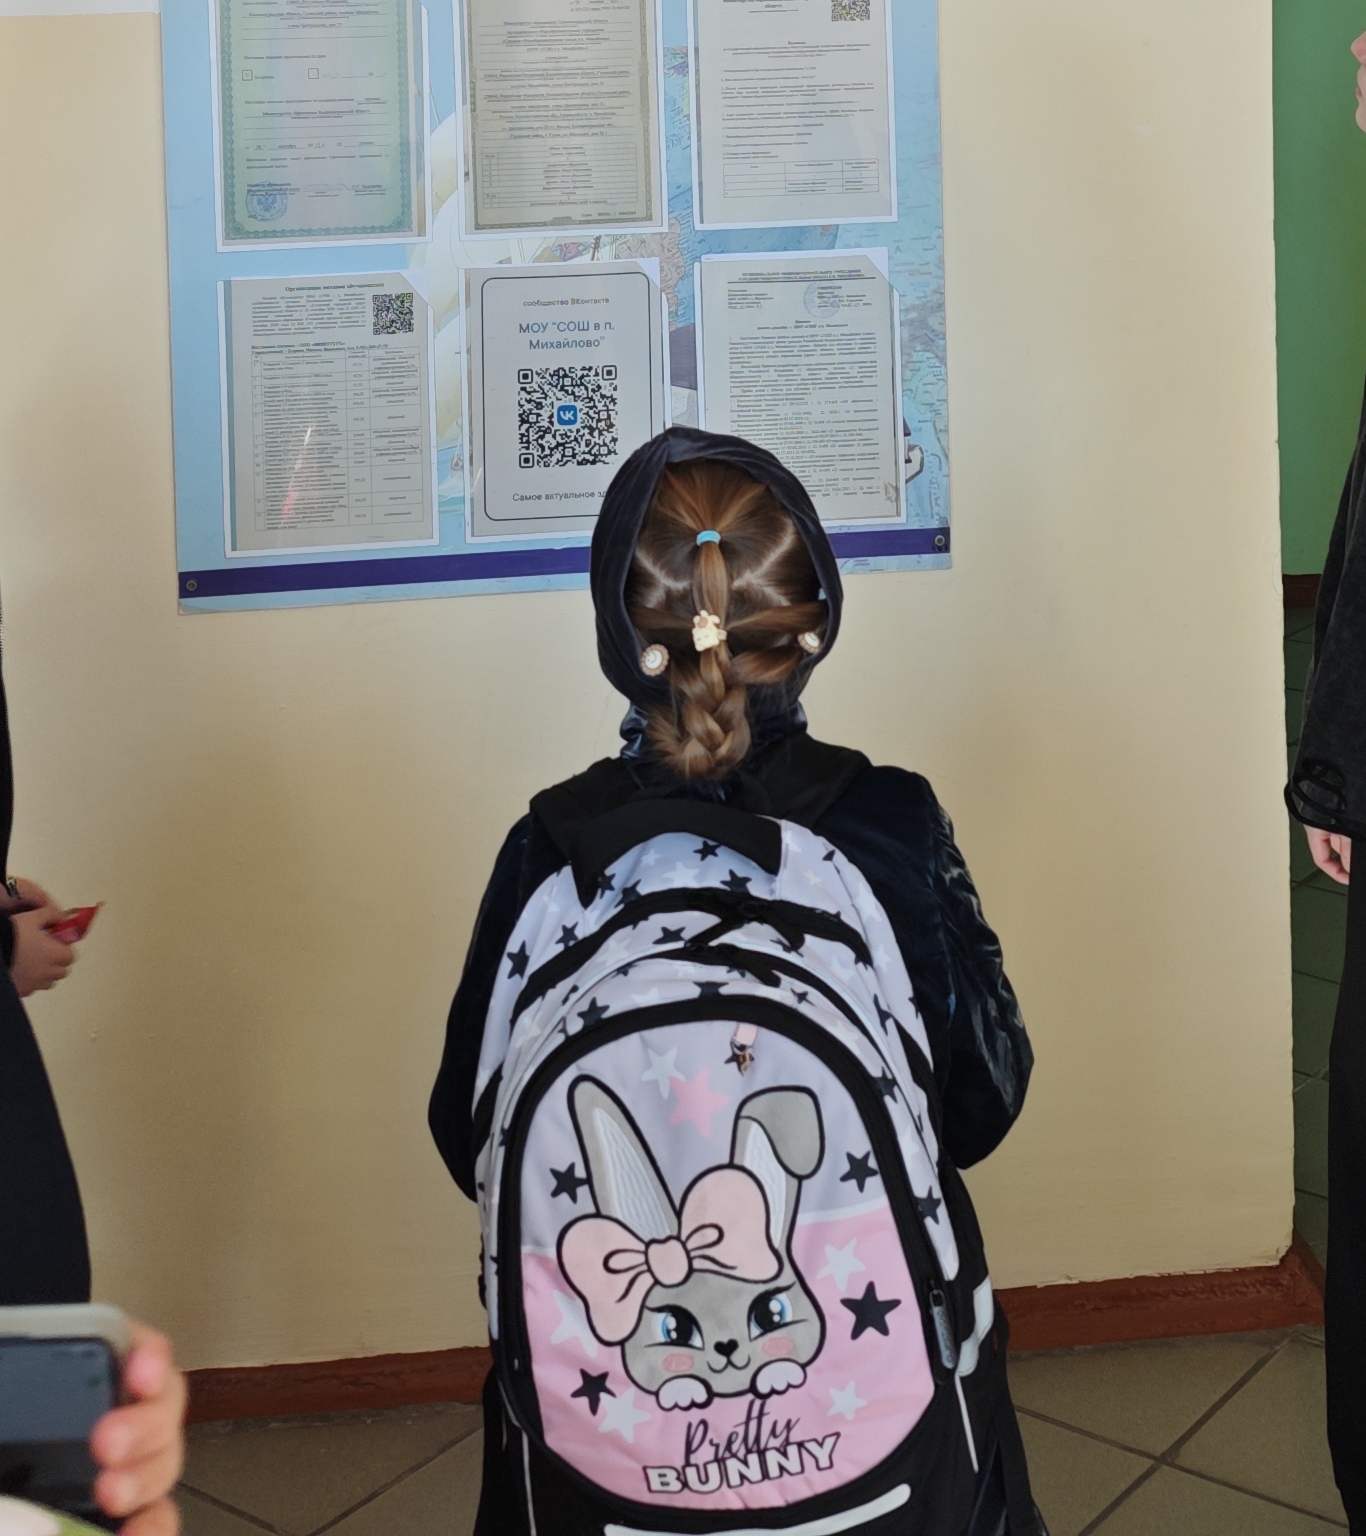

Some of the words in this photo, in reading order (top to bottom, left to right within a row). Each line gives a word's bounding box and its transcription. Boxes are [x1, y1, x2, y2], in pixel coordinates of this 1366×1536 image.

[571, 297, 610, 306] ВКонтакте
[519, 321, 550, 334] МОУ
[551, 320, 590, 333] "СОШ
[594, 323, 601, 331] в
[529, 335, 605, 350] Михайлово"
[512, 492, 542, 502] Самое
[544, 490, 595, 502] актуальное
[685, 1398, 800, 1464] Pretty
[643, 1431, 841, 1493] BUNNY
